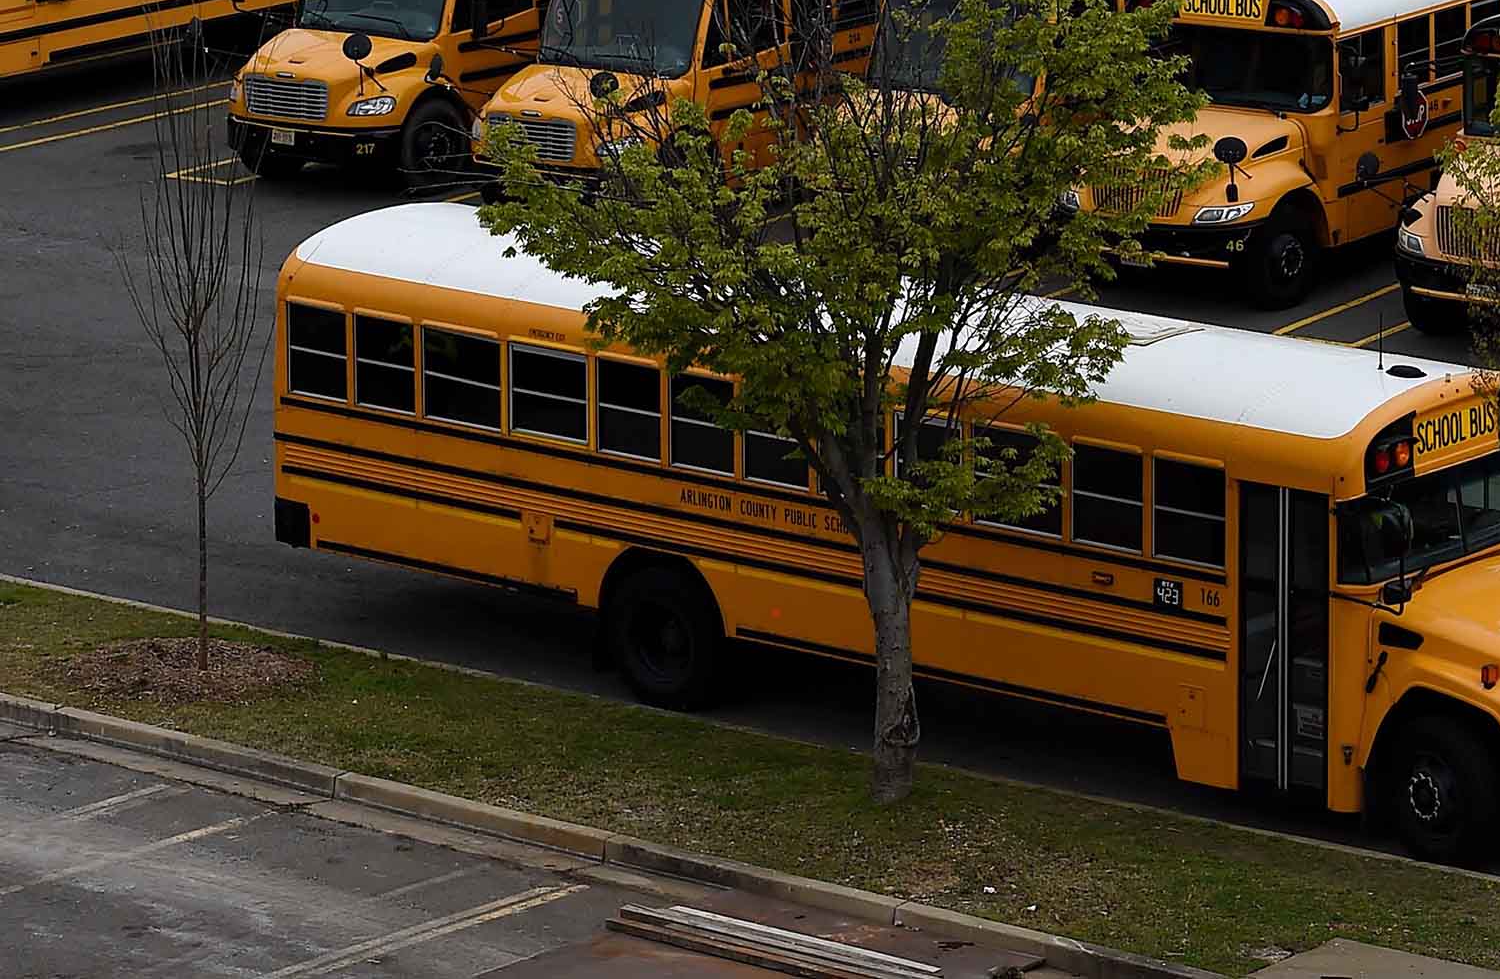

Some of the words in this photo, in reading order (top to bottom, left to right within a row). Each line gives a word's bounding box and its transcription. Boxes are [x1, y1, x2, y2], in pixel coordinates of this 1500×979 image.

[356, 143, 376, 155] 217
[1225, 238, 1245, 252] 46
[1416, 411, 1466, 454] SCHOOL
[1469, 401, 1496, 439] BUS
[680, 488, 732, 511] ARLINGTON
[740, 499, 777, 520] COUNTY
[784, 508, 817, 530] PUBLIC
[1157, 587, 1179, 605] 423
[1201, 588, 1220, 607] 166
